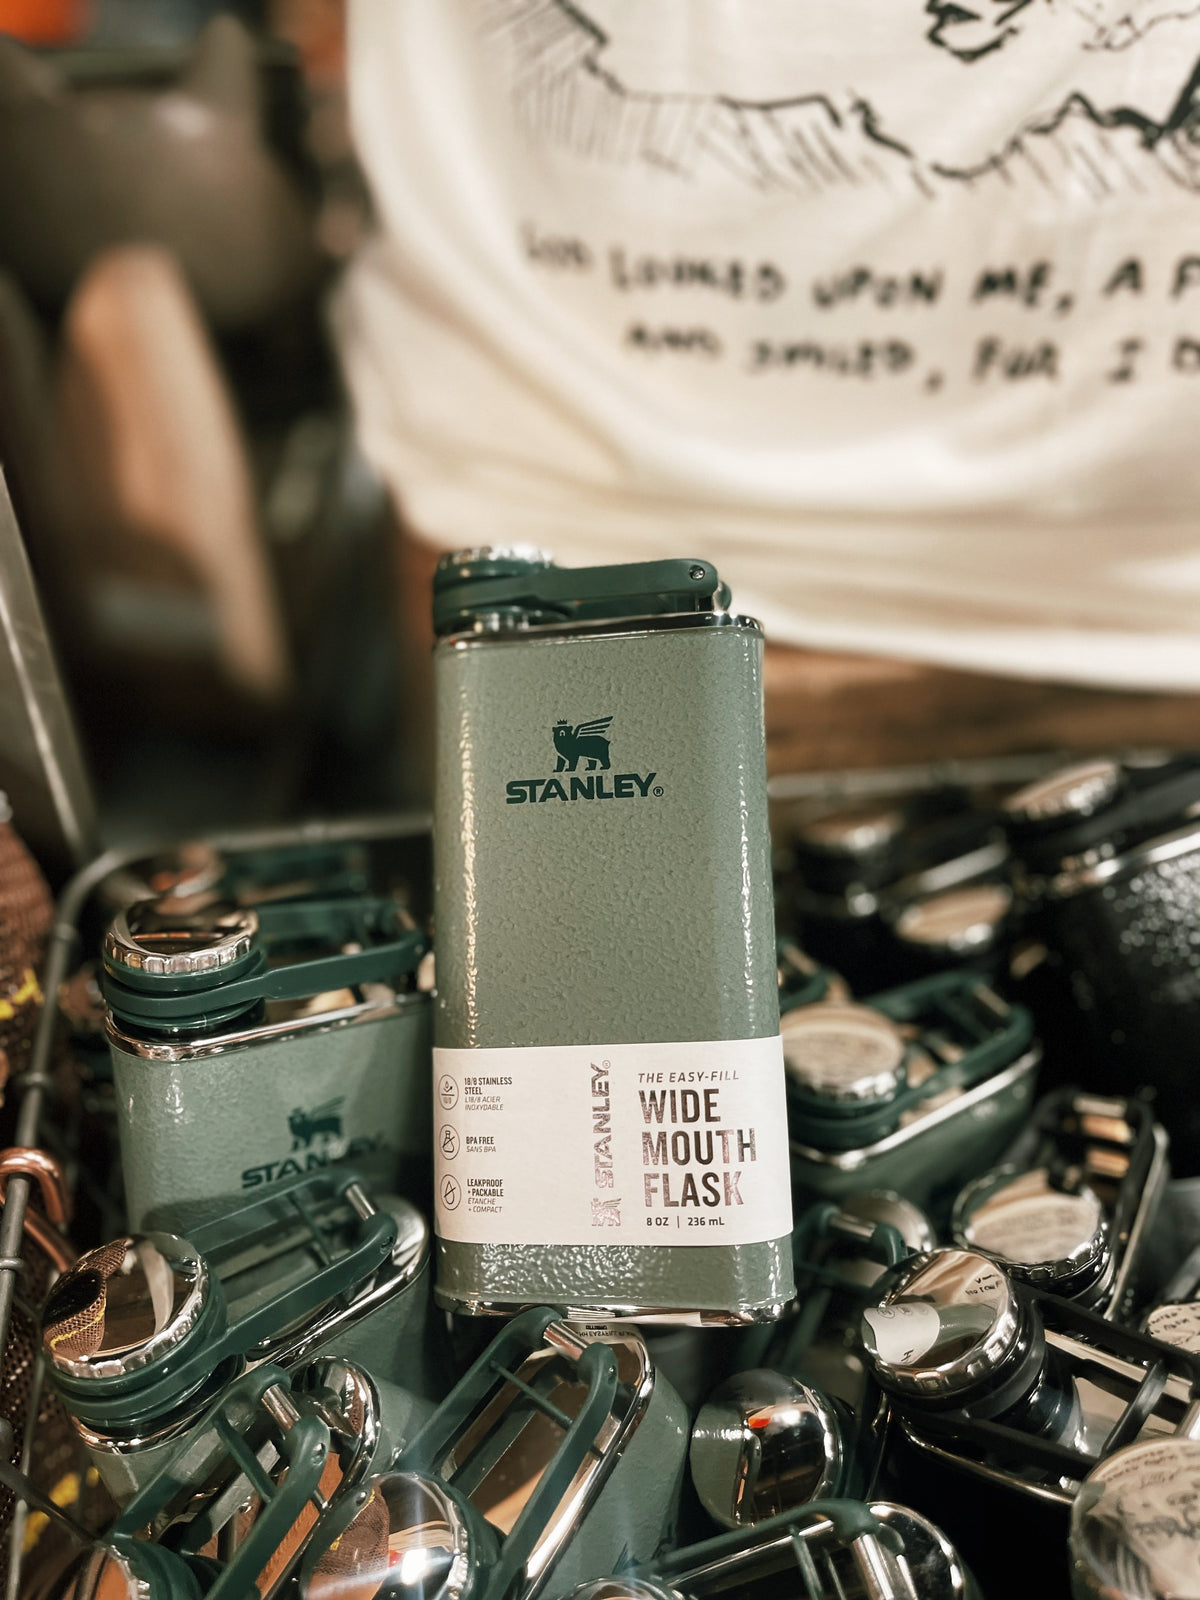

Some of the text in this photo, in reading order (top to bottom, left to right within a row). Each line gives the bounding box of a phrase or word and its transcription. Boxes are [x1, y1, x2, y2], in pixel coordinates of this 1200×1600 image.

[1100, 254, 1144, 298] A
[478, 1076, 513, 1086] STAINLESS
[638, 1070, 740, 1083] THE EASY-FILL
[464, 1086, 483, 1095] STEEL
[482, 1095, 501, 1103] ACIER
[638, 1088, 721, 1124] WIDE
[465, 1136, 494, 1145] BPA FREE
[466, 1145, 497, 1153] SANS BPA
[641, 1127, 757, 1166] MOUTH
[467, 1178, 503, 1187] LEAKPROOF
[472, 1188, 504, 1197] PACKABLE
[643, 1171, 744, 1208] FLASK
[473, 1205, 503, 1213] COMPACT
[646, 1216, 725, 1226] 8 OZ 236 mL
